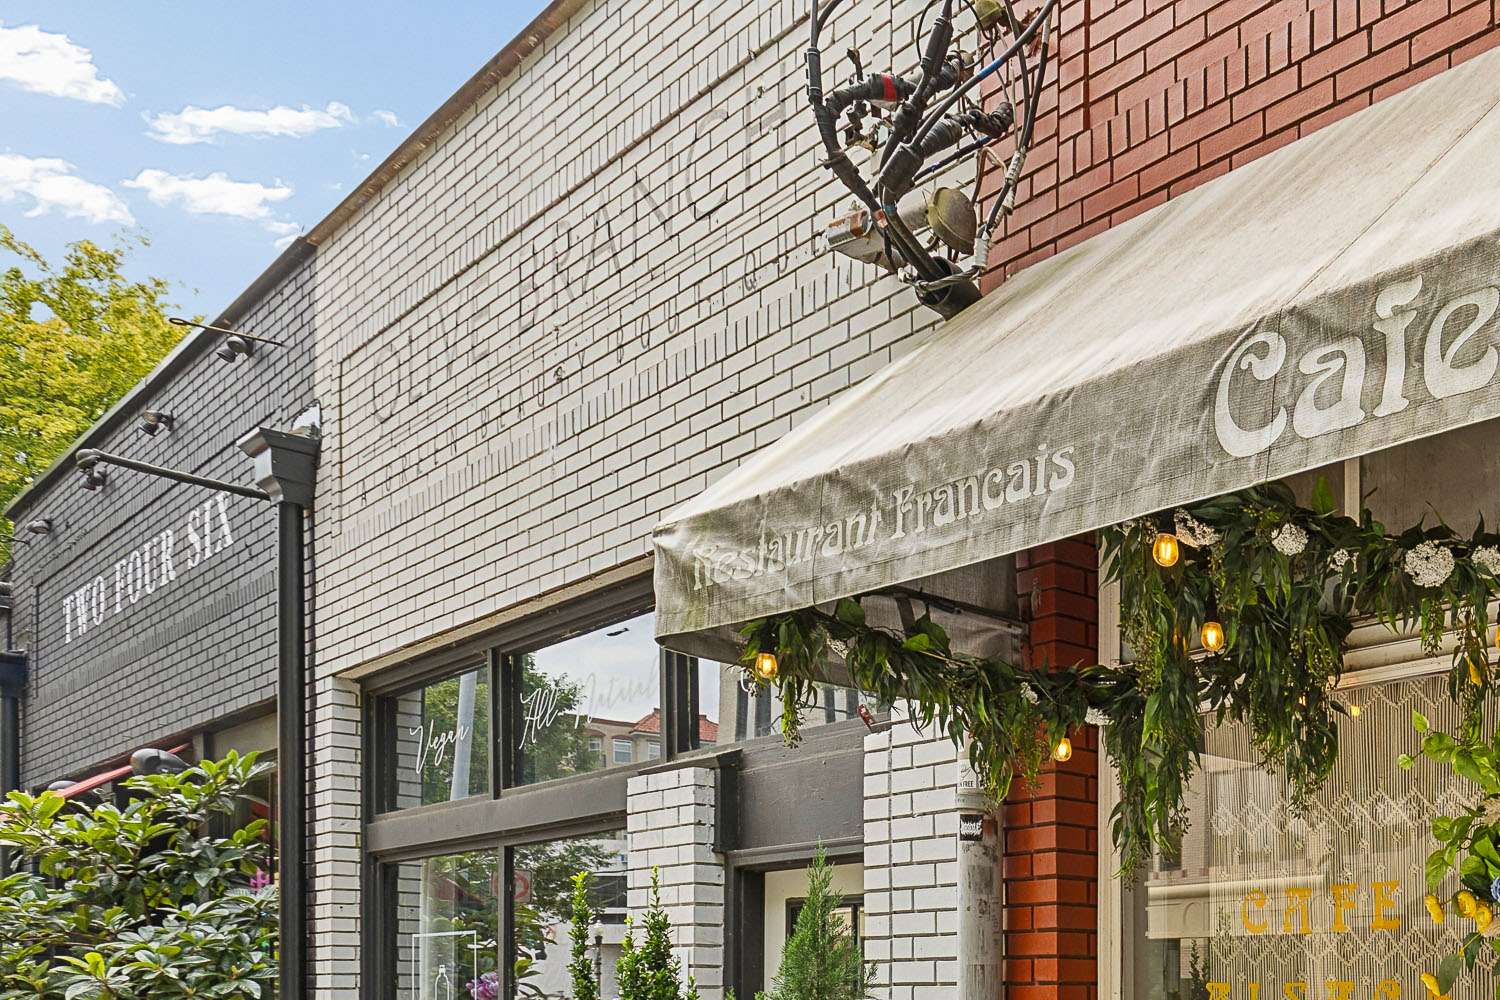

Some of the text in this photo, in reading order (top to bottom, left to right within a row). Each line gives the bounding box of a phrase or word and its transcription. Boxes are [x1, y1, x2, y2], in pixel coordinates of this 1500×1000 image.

[62, 490, 234, 644] TWO FOUR SIX
[409, 718, 470, 775] Vegan
[1240, 879, 1401, 936] CAFE
